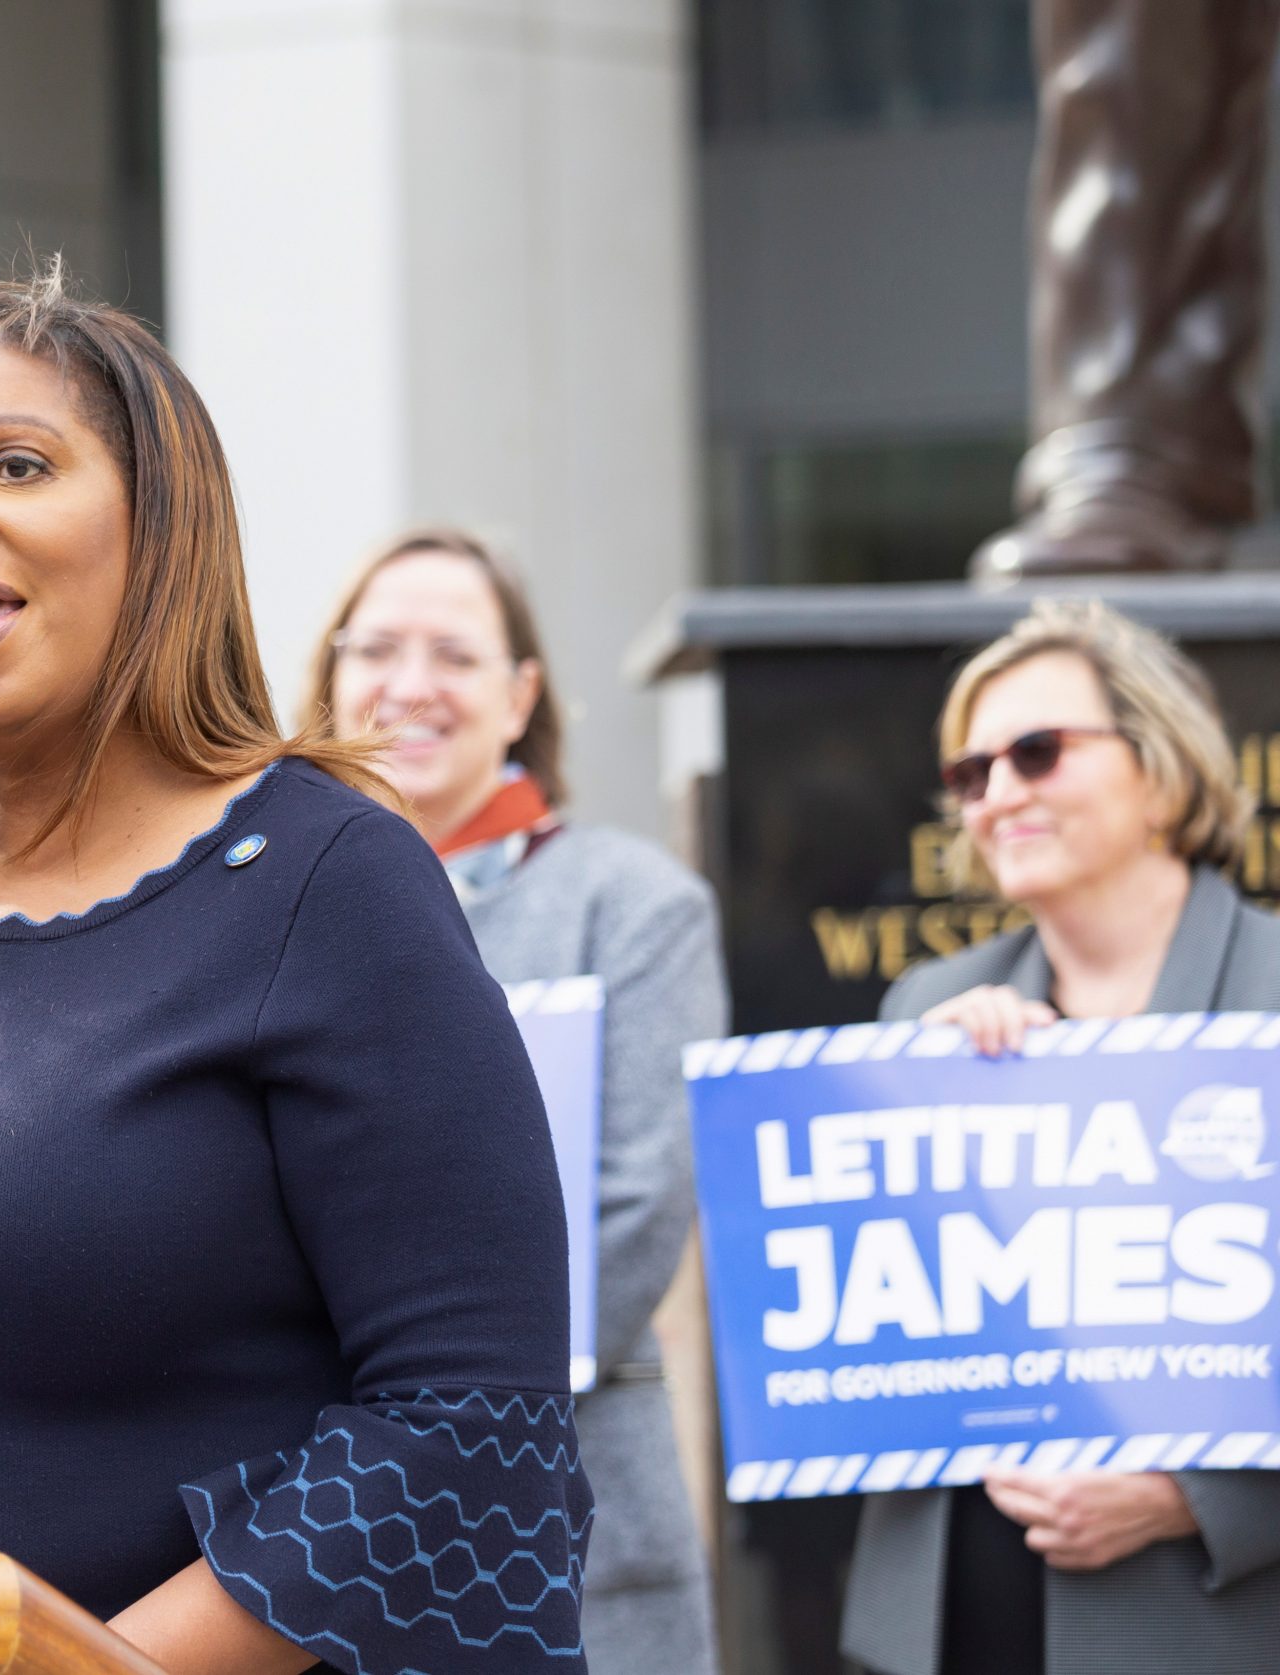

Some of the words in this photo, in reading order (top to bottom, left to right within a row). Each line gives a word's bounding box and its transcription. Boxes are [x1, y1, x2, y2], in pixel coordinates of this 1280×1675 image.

[756, 1101, 1158, 1208] LETITIA
[763, 1203, 1275, 1351] JAMES
[766, 1368, 831, 1408] FOR
[831, 1353, 1011, 1402] GOVERNOR
[1013, 1350, 1064, 1388] OF
[1066, 1346, 1157, 1383] NEW
[1160, 1344, 1272, 1379] YORK
